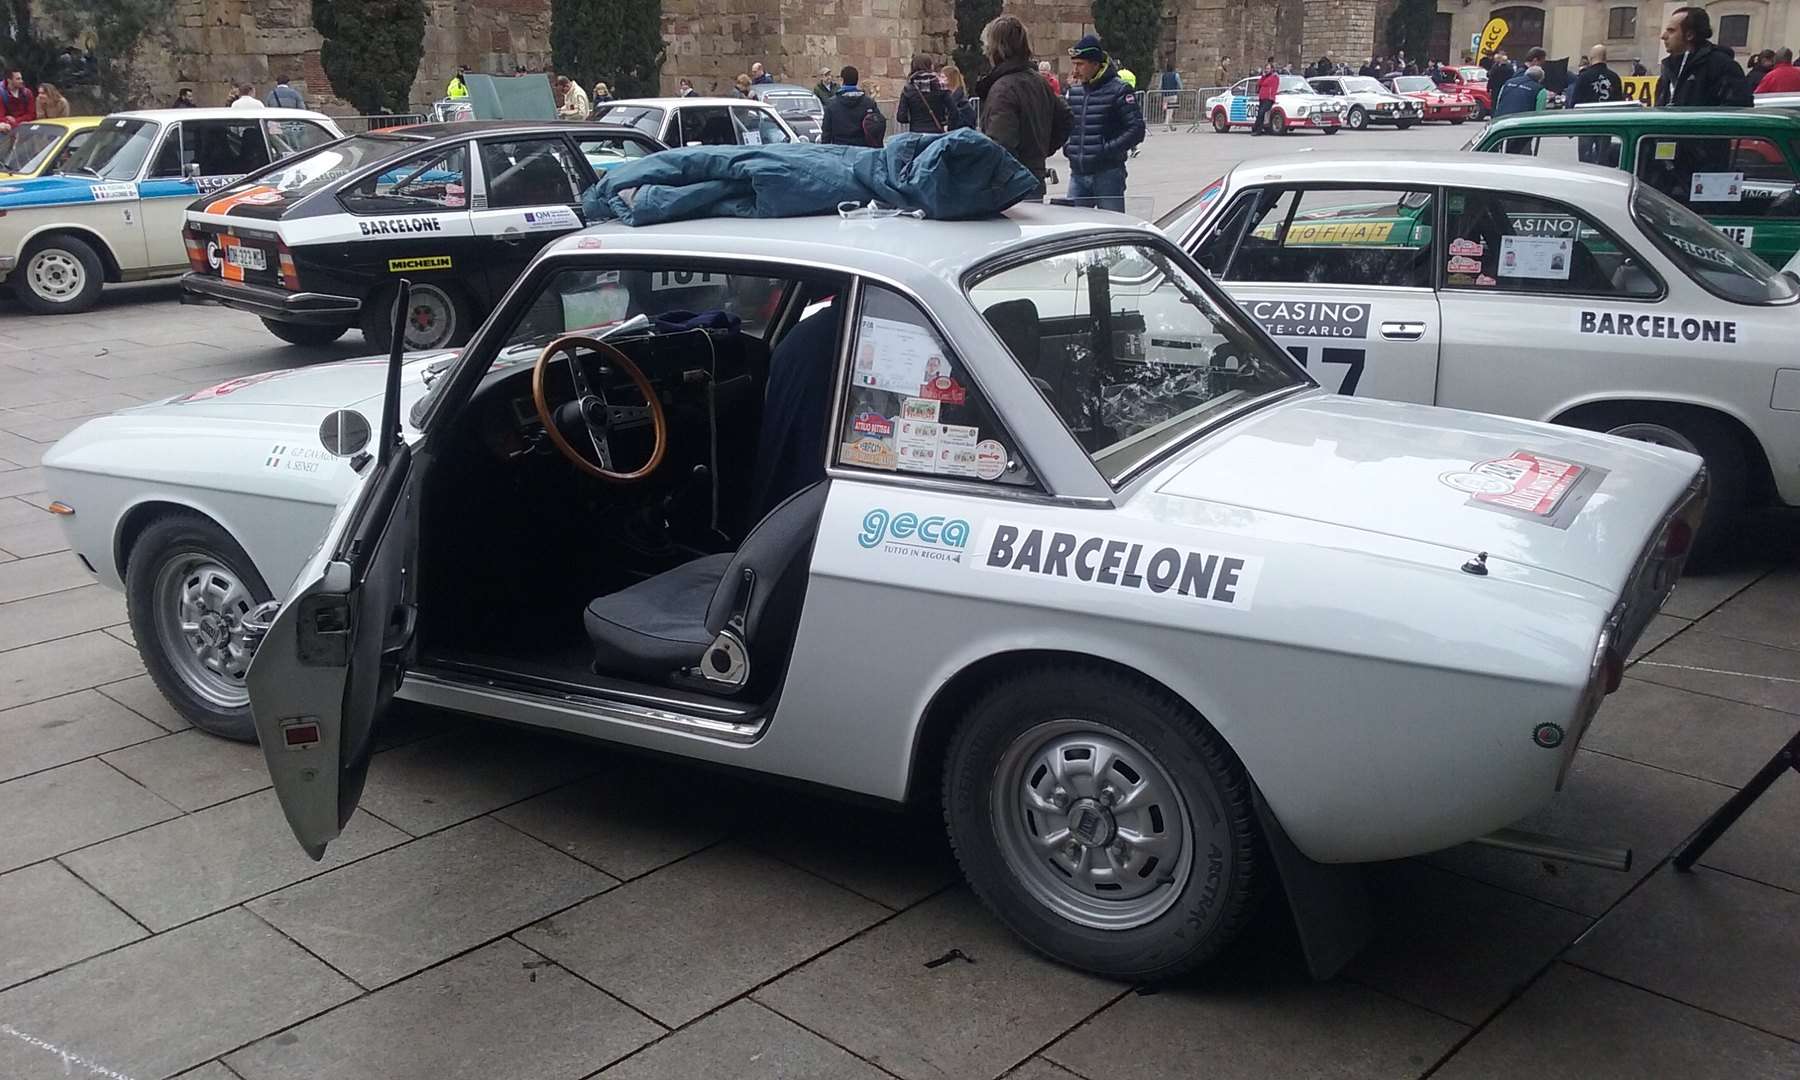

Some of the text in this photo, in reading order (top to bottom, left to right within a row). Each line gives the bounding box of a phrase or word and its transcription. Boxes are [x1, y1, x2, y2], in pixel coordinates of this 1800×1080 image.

[1481, 26, 1501, 55] RACC
[1622, 82, 1660, 107] RA
[358, 217, 441, 235] BARCELONE
[1512, 219, 1575, 232] ASINO
[391, 258, 450, 269] MICHELIN
[1253, 302, 1364, 323] CASINO
[1580, 311, 1736, 343] BARCELONE
[858, 508, 970, 549] geca
[986, 524, 1245, 603] BARCELONE
